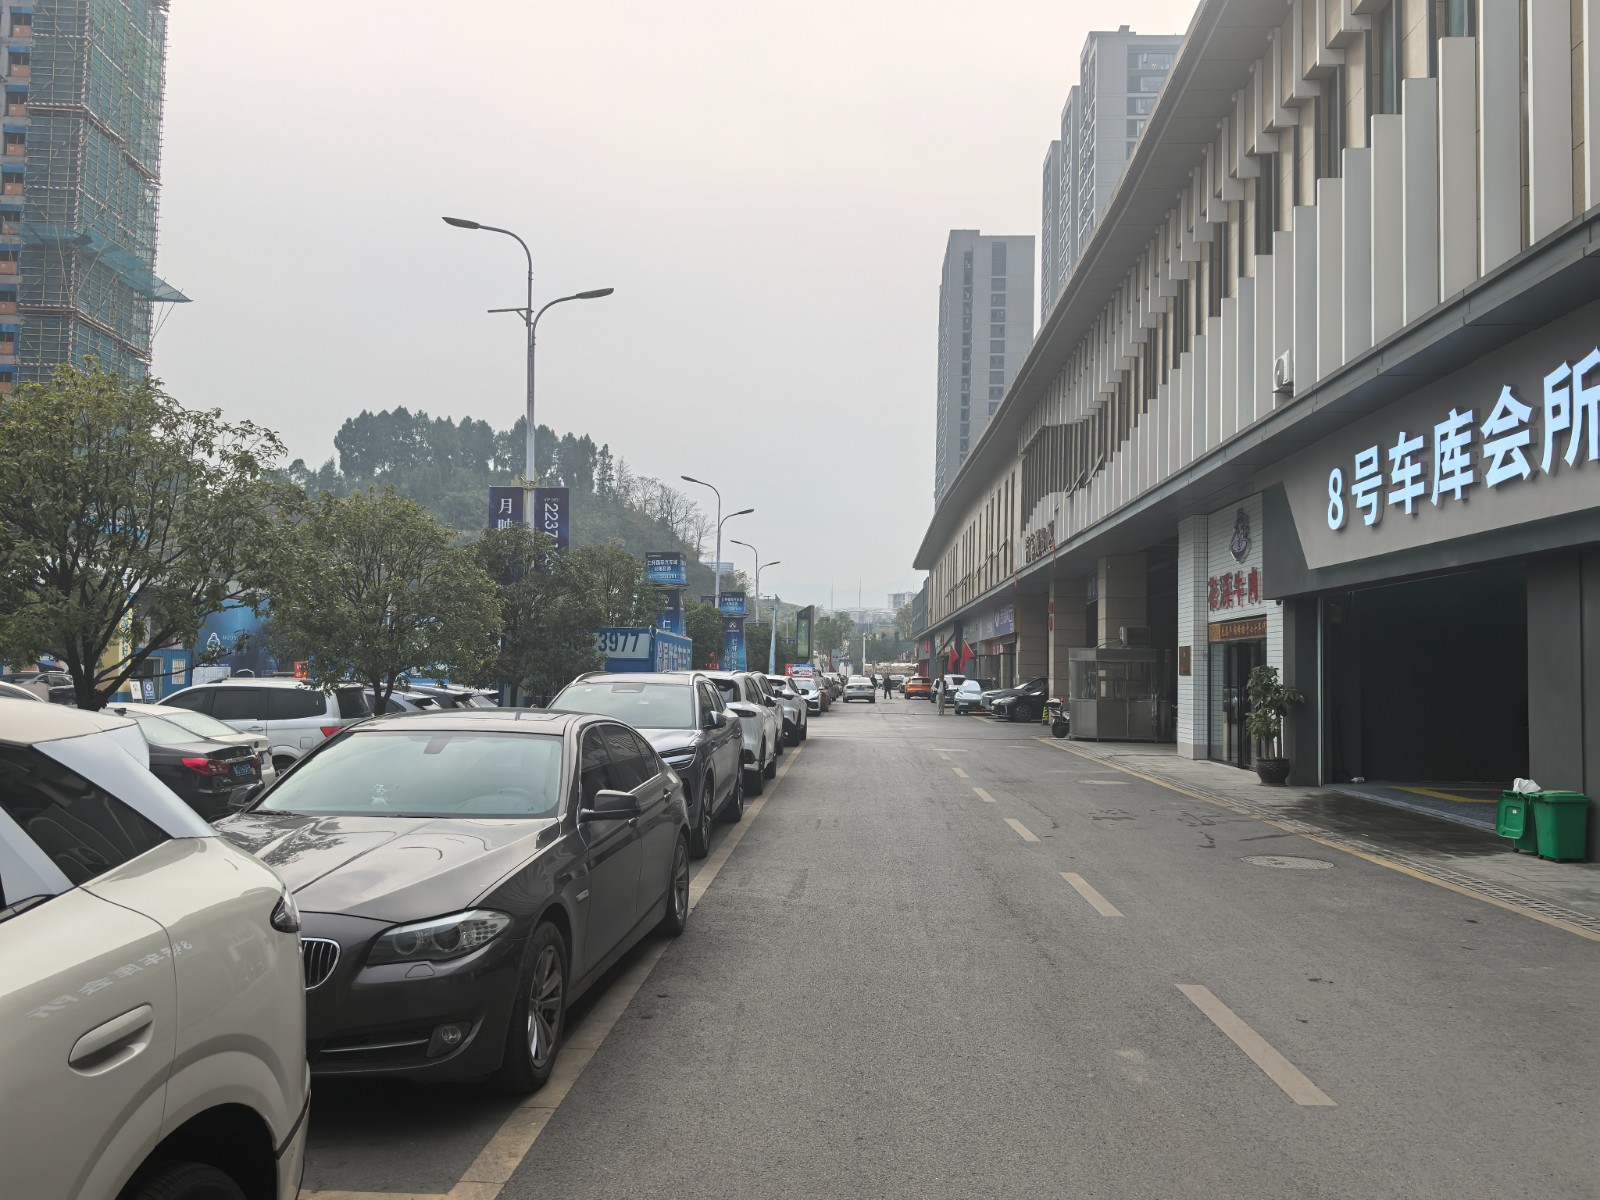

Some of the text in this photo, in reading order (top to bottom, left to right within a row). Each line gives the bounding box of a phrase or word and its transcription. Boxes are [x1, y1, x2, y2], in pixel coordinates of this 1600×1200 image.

[1327, 346, 1600, 531] 8号车库会所
